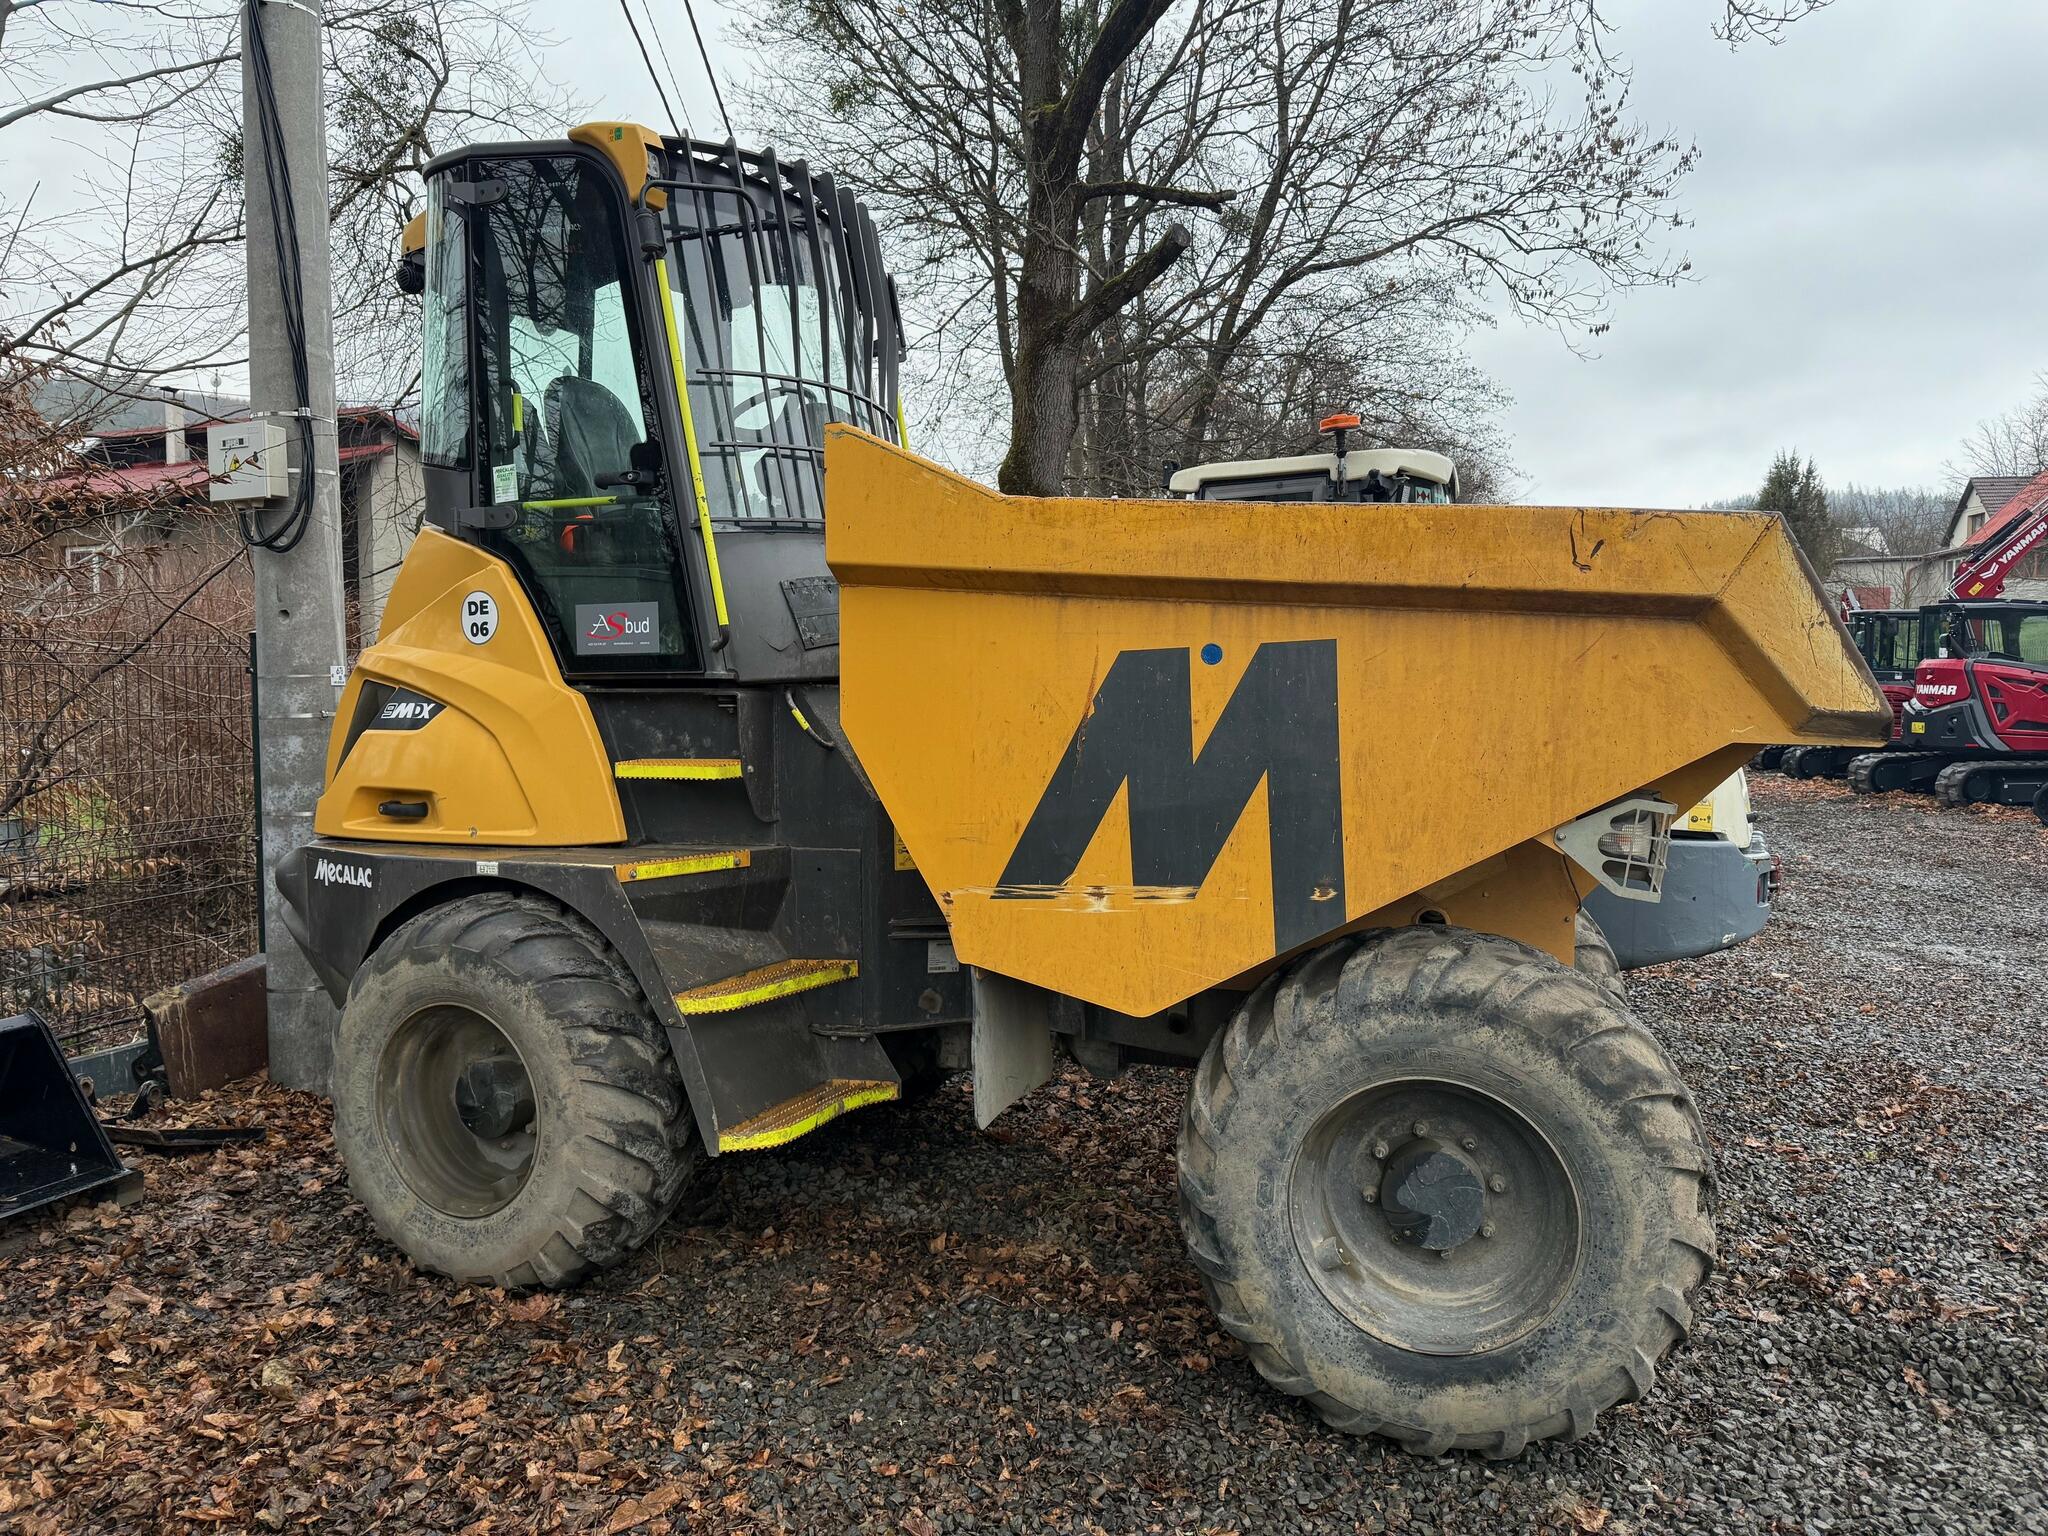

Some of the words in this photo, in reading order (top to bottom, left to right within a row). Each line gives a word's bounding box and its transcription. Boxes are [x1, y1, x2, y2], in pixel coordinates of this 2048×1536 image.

[1998, 521, 2048, 564] YANMAR
[468, 600, 489, 616] DE
[470, 621, 489, 637] 06
[991, 638, 1347, 956] M
